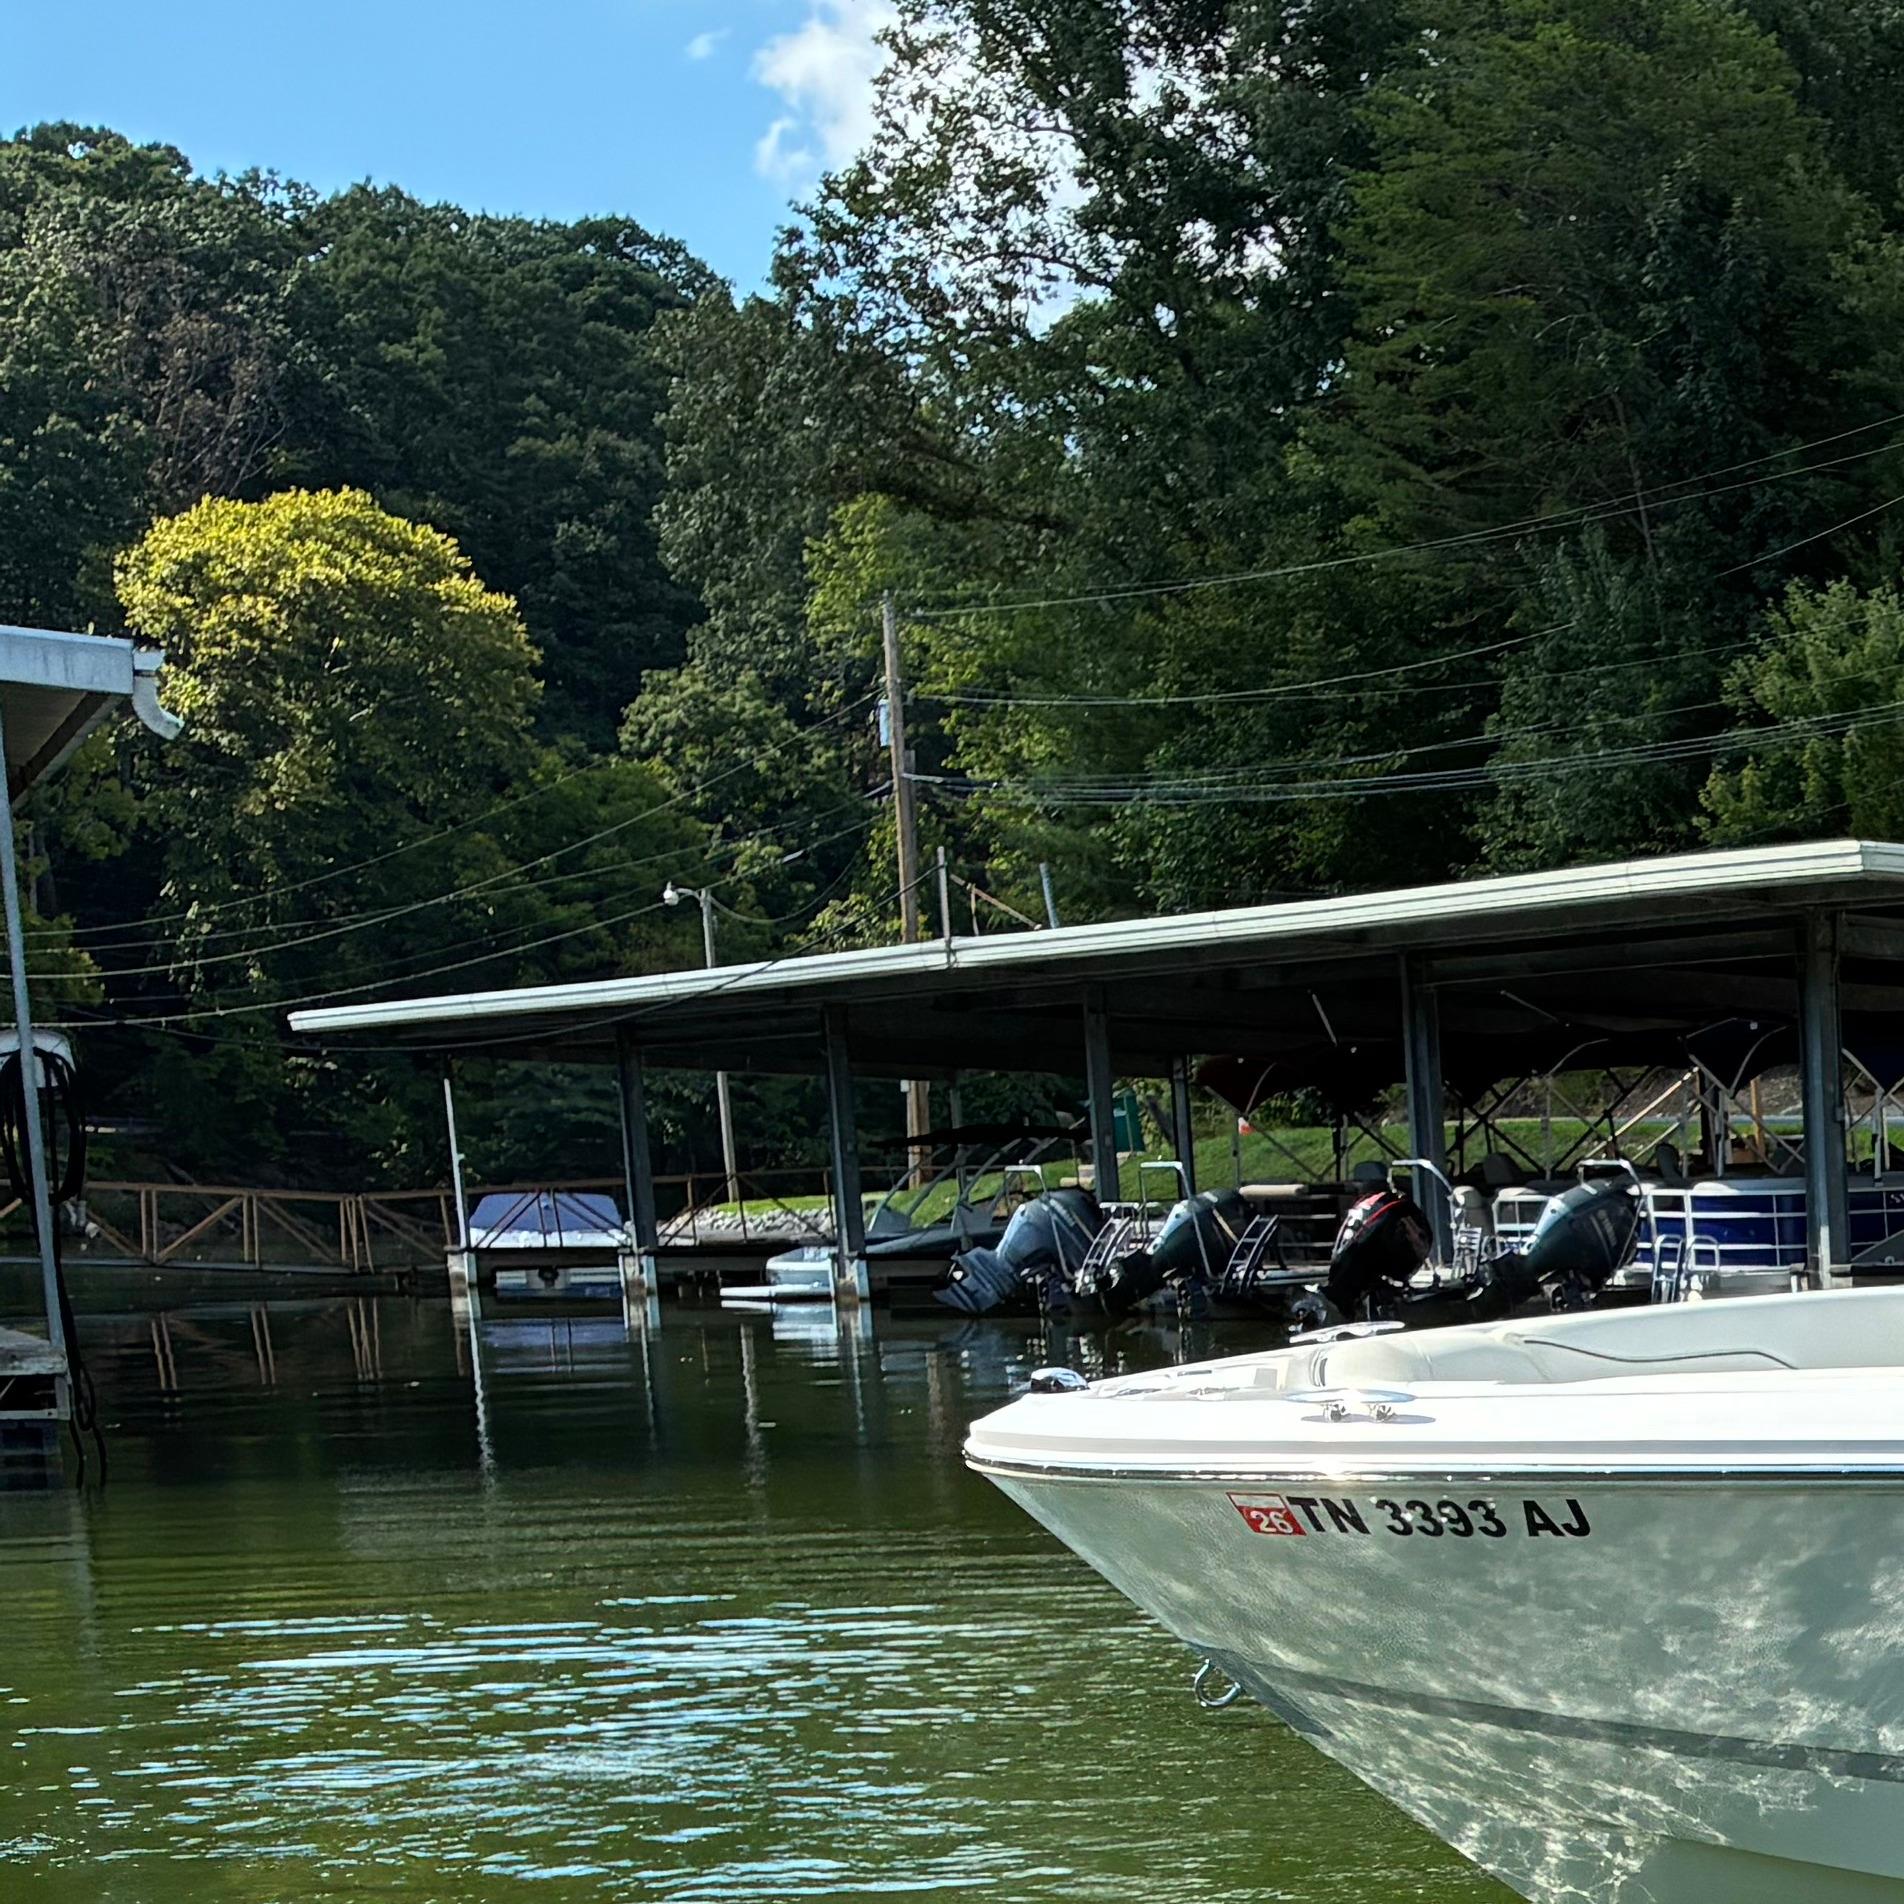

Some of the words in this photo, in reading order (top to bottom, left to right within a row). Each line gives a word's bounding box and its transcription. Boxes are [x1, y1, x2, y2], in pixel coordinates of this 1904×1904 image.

[1251, 1507, 1296, 1535] 26
[1286, 1496, 1372, 1535] TN
[1375, 1498, 1508, 1538] 3393
[1522, 1498, 1591, 1538] AJ
